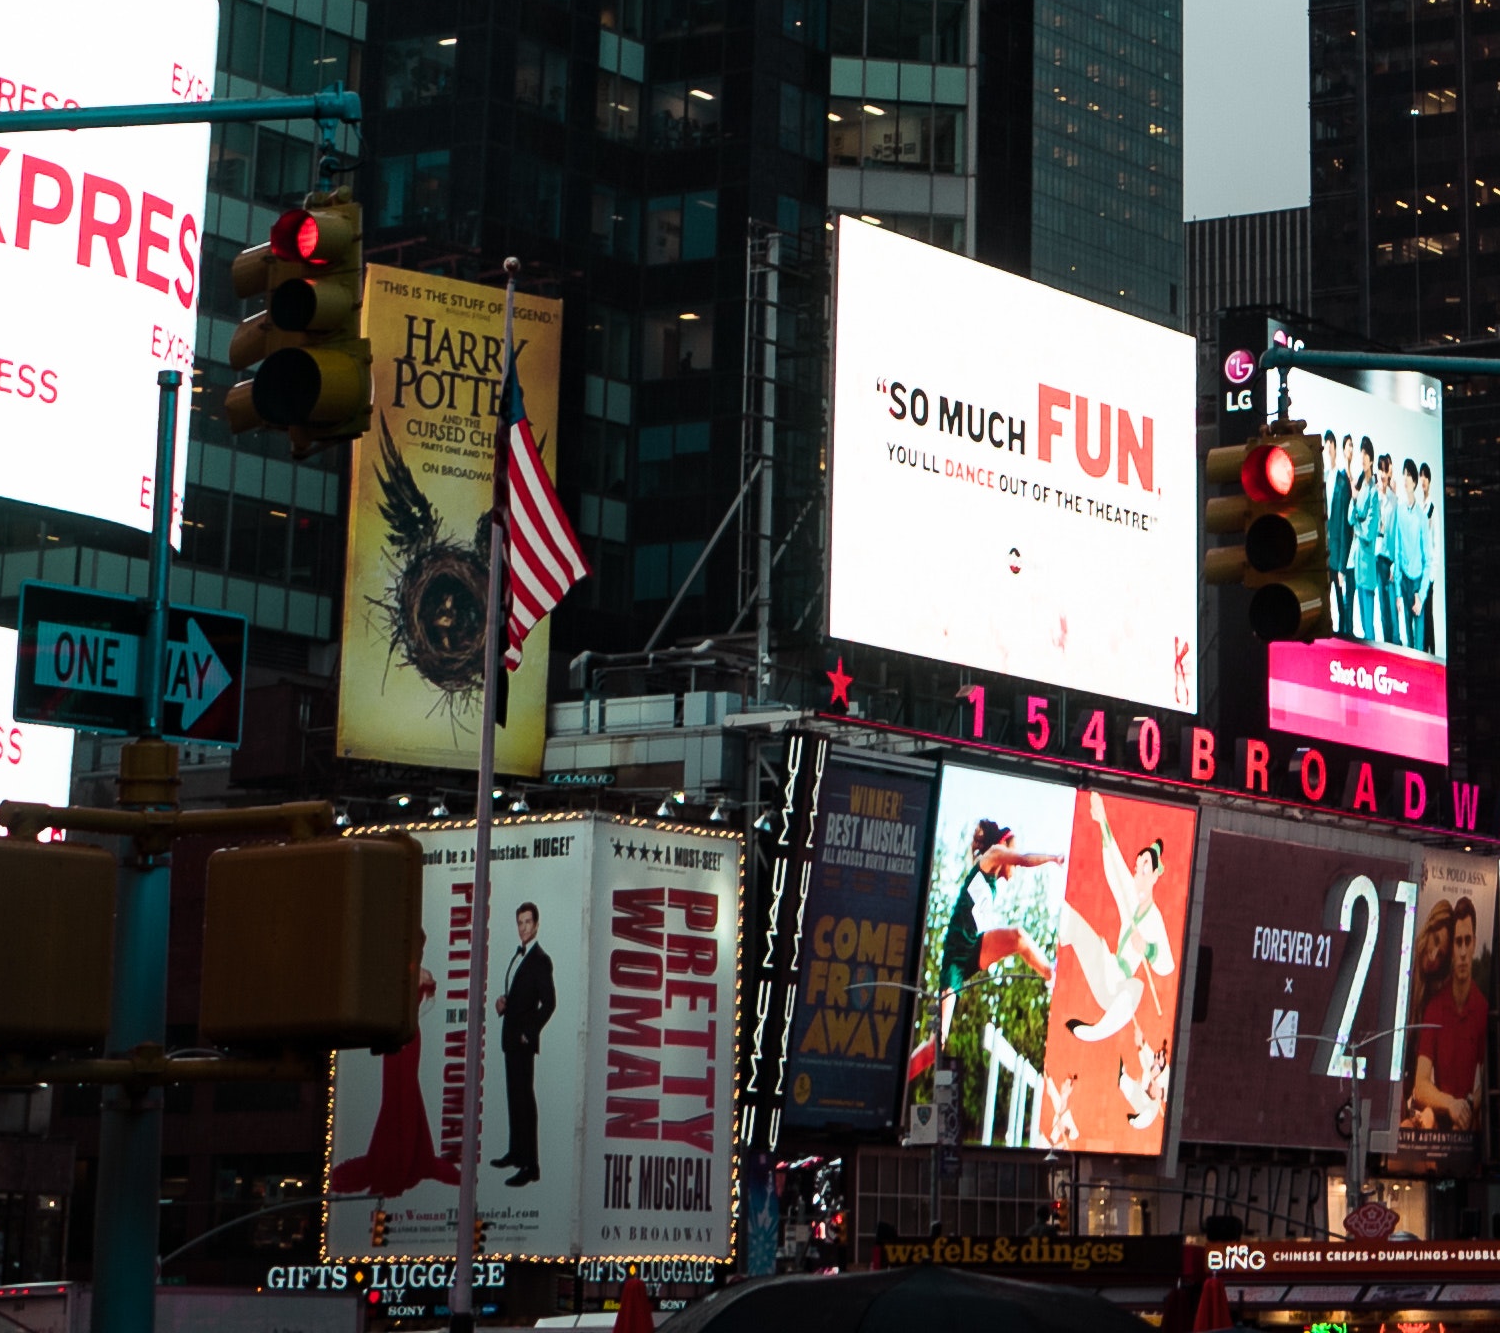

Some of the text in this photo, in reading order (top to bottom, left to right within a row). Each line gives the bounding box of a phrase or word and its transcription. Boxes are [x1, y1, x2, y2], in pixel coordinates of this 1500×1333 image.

[412, 287, 422, 299] IS
[425, 289, 448, 305] THE
[450, 294, 485, 311] STUFF
[488, 302, 504, 315] OF
[512, 306, 559, 324] EGEND.”
[392, 356, 530, 425] POTTE
[1226, 390, 1252, 412] LG
[1420, 384, 1437, 411] LG
[406, 418, 466, 444] CURSED
[442, 414, 481, 429] AND THE
[939, 395, 1026, 455] MUCH
[422, 462, 493, 482] ON BROADWA
[945, 459, 995, 489] DANCE
[999, 475, 1027, 498] OUT
[1032, 483, 1051, 503] OF
[1055, 489, 1082, 513] THE
[54, 632, 213, 699] ONE AY
[1356, 667, 1373, 690] On
[966, 685, 1161, 771] 1540
[851, 784, 904, 820] WINNER!
[825, 813, 916, 858] BEST MUSICAL
[446, 849, 458, 863] be
[665, 846, 671, 865] A
[822, 847, 915, 875] ALL ACROSS NORTH AMERICA
[813, 915, 908, 967] COME
[1253, 926, 1332, 968] FOREVER 21
[1326, 874, 1418, 1081] 21
[605, 888, 665, 1140] WOMAN
[661, 887, 718, 1153] PRETTY
[799, 1009, 898, 1060] AWAY
[604, 1154, 712, 1211] THE MUSICAL
[602, 1226, 713, 1243] ON BROADWAY
[884, 1236, 1125, 1269] wafels&dinges
[1207, 1249, 1266, 1270] BING
[1273, 1251, 1322, 1262] CHINESE
[1327, 1251, 1369, 1262] CREPES
[1378, 1250, 1449, 1262] DUMPLINGS
[267, 1266, 349, 1291] GIFTS
[578, 1261, 715, 1284] GIFTS LUGGAGE
[382, 1289, 406, 1305] NY
[388, 1305, 425, 1317] SONY
[659, 1300, 688, 1311] SONY
